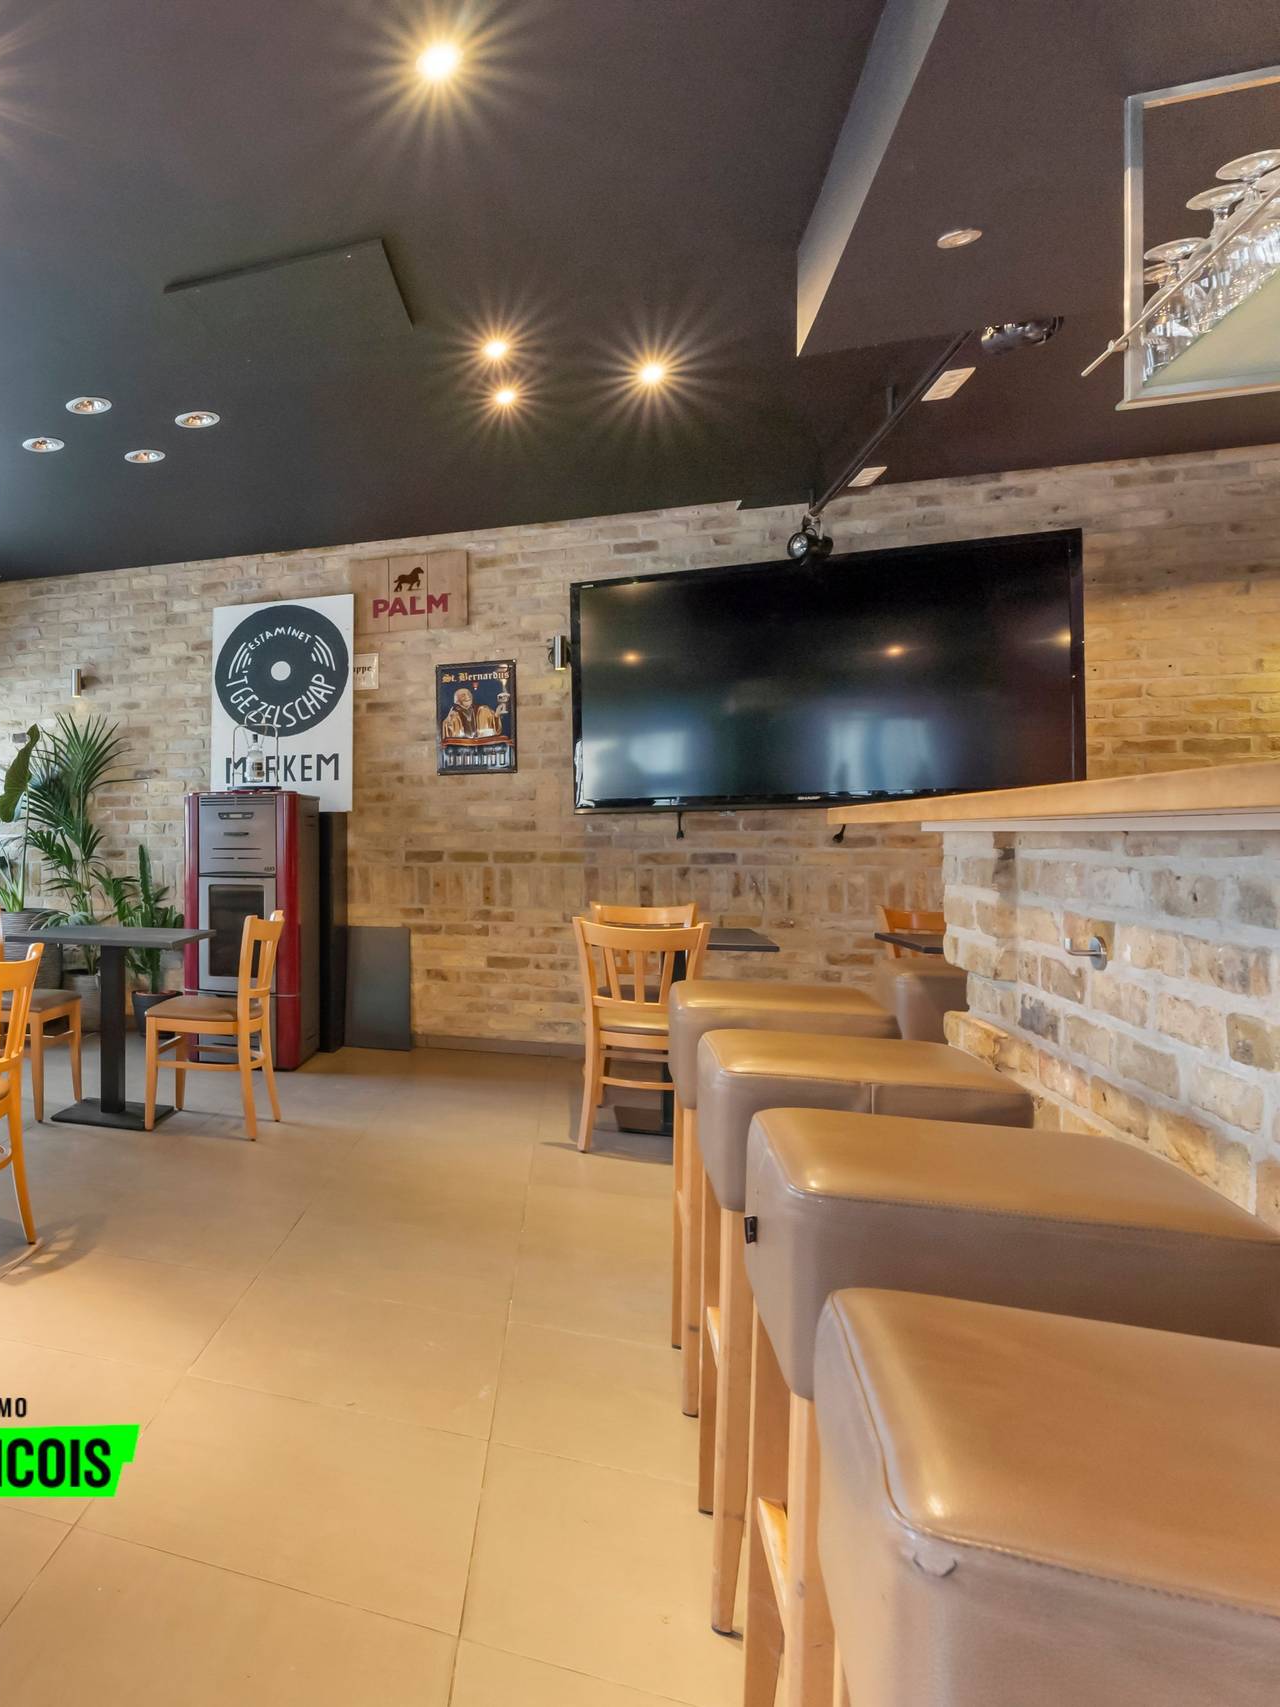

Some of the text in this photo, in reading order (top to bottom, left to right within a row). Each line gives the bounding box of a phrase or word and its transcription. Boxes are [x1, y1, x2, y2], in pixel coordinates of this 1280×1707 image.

[373, 593, 448, 618] PALM
[248, 626, 312, 650] ESTAMINET
[459, 671, 510, 681] Bernardus
[230, 673, 336, 728] GEZELSCHAP
